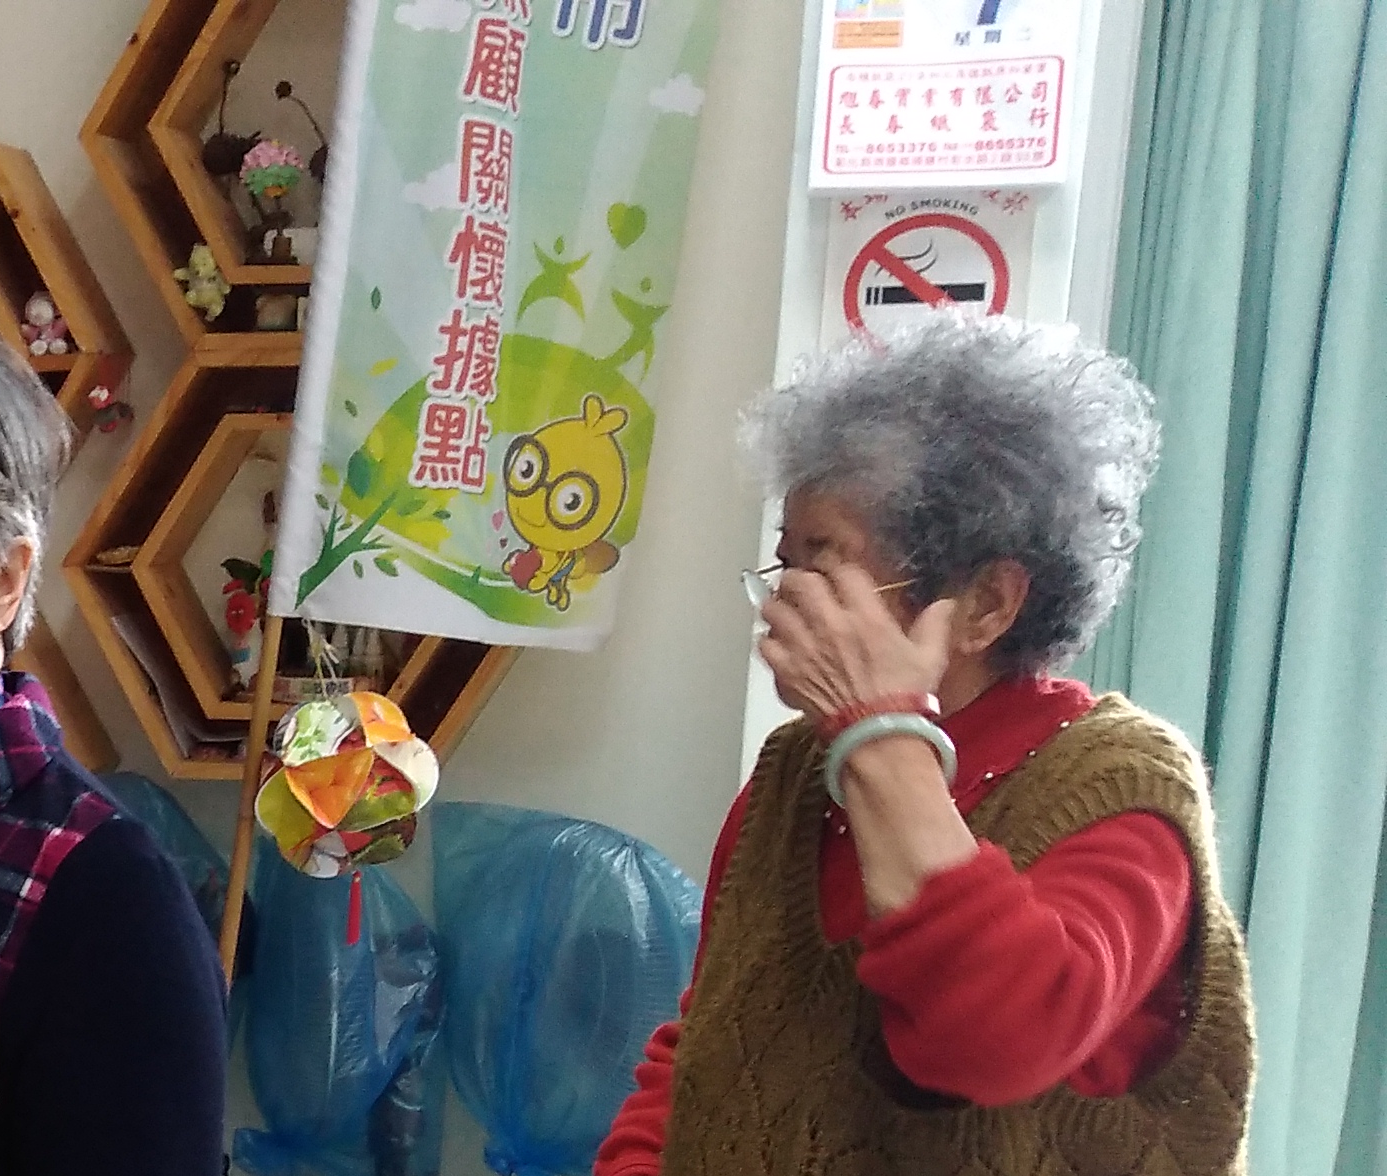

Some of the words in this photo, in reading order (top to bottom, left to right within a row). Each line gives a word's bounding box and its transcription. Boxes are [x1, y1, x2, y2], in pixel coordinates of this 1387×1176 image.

[415, 0, 529, 487] 顧關懷據點
[885, 204, 907, 220] NO
[911, 197, 979, 216] SMOKING
